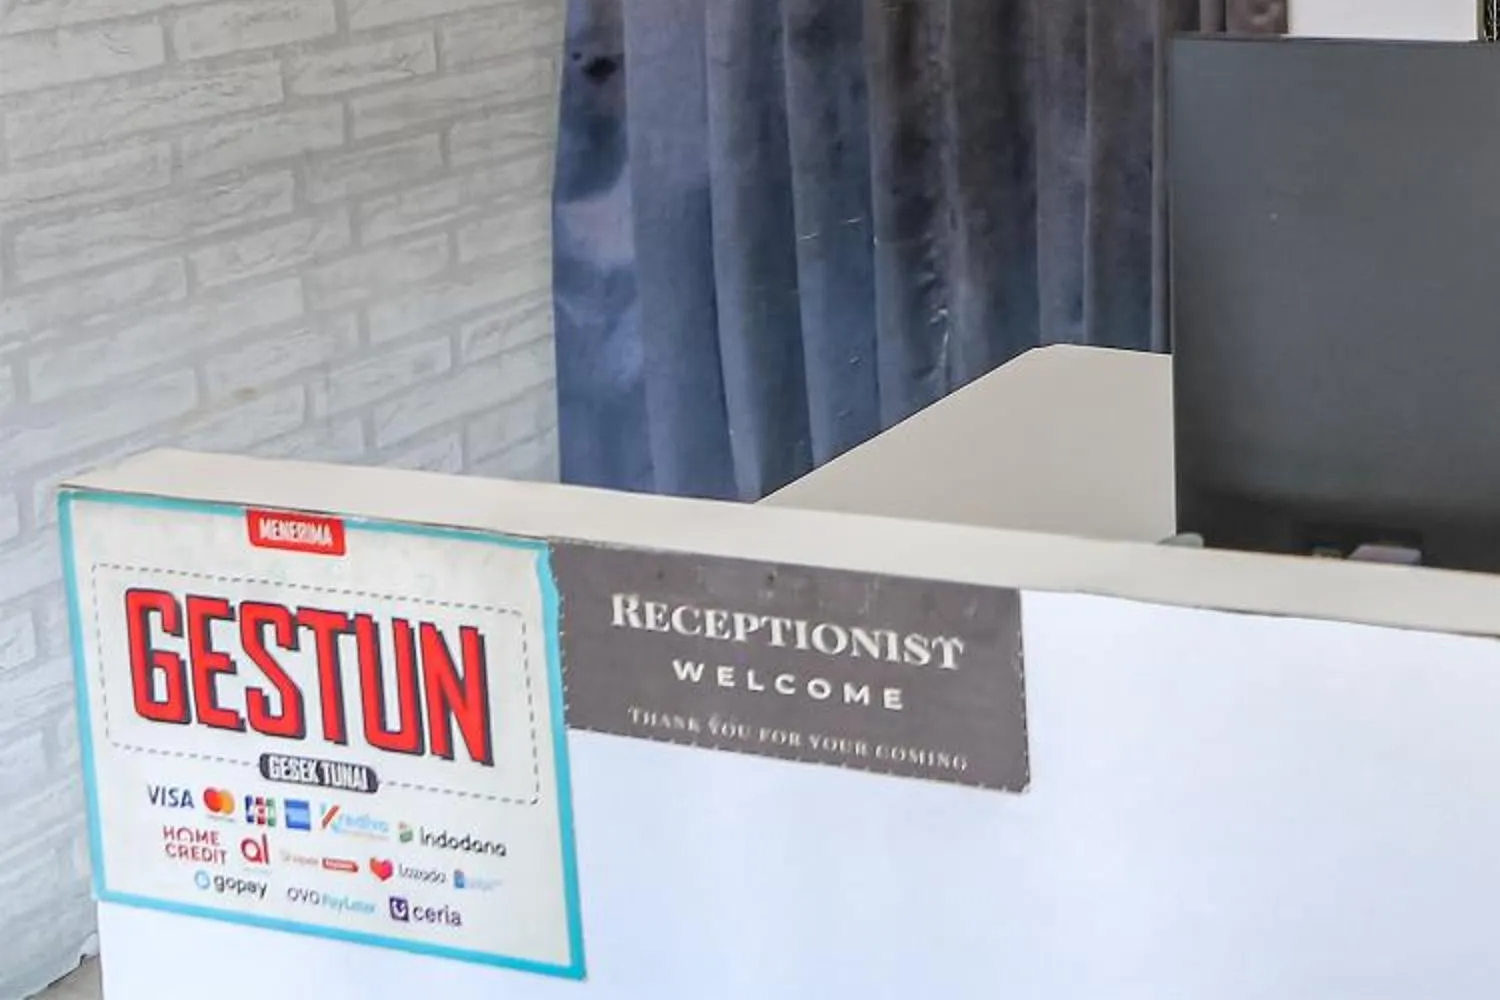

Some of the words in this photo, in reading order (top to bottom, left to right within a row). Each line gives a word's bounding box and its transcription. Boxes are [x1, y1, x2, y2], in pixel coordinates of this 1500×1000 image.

[258, 517, 334, 548] MENERIMA
[610, 592, 965, 671] RECEPTIONIST
[124, 587, 496, 767] GESTUN
[672, 659, 904, 711] WELCOME
[627, 705, 700, 735] THANK
[707, 715, 753, 741] YOU
[759, 726, 801, 749] FOR
[809, 734, 868, 759] YOUR
[875, 744, 970, 772] COMING
[268, 754, 320, 784] GESEK
[320, 761, 370, 791] TUNAI
[148, 785, 195, 809] VISA
[163, 825, 221, 846] HOME
[165, 843, 228, 865] CREDIT
[213, 874, 269, 900] gopay
[413, 905, 463, 927] ceria
